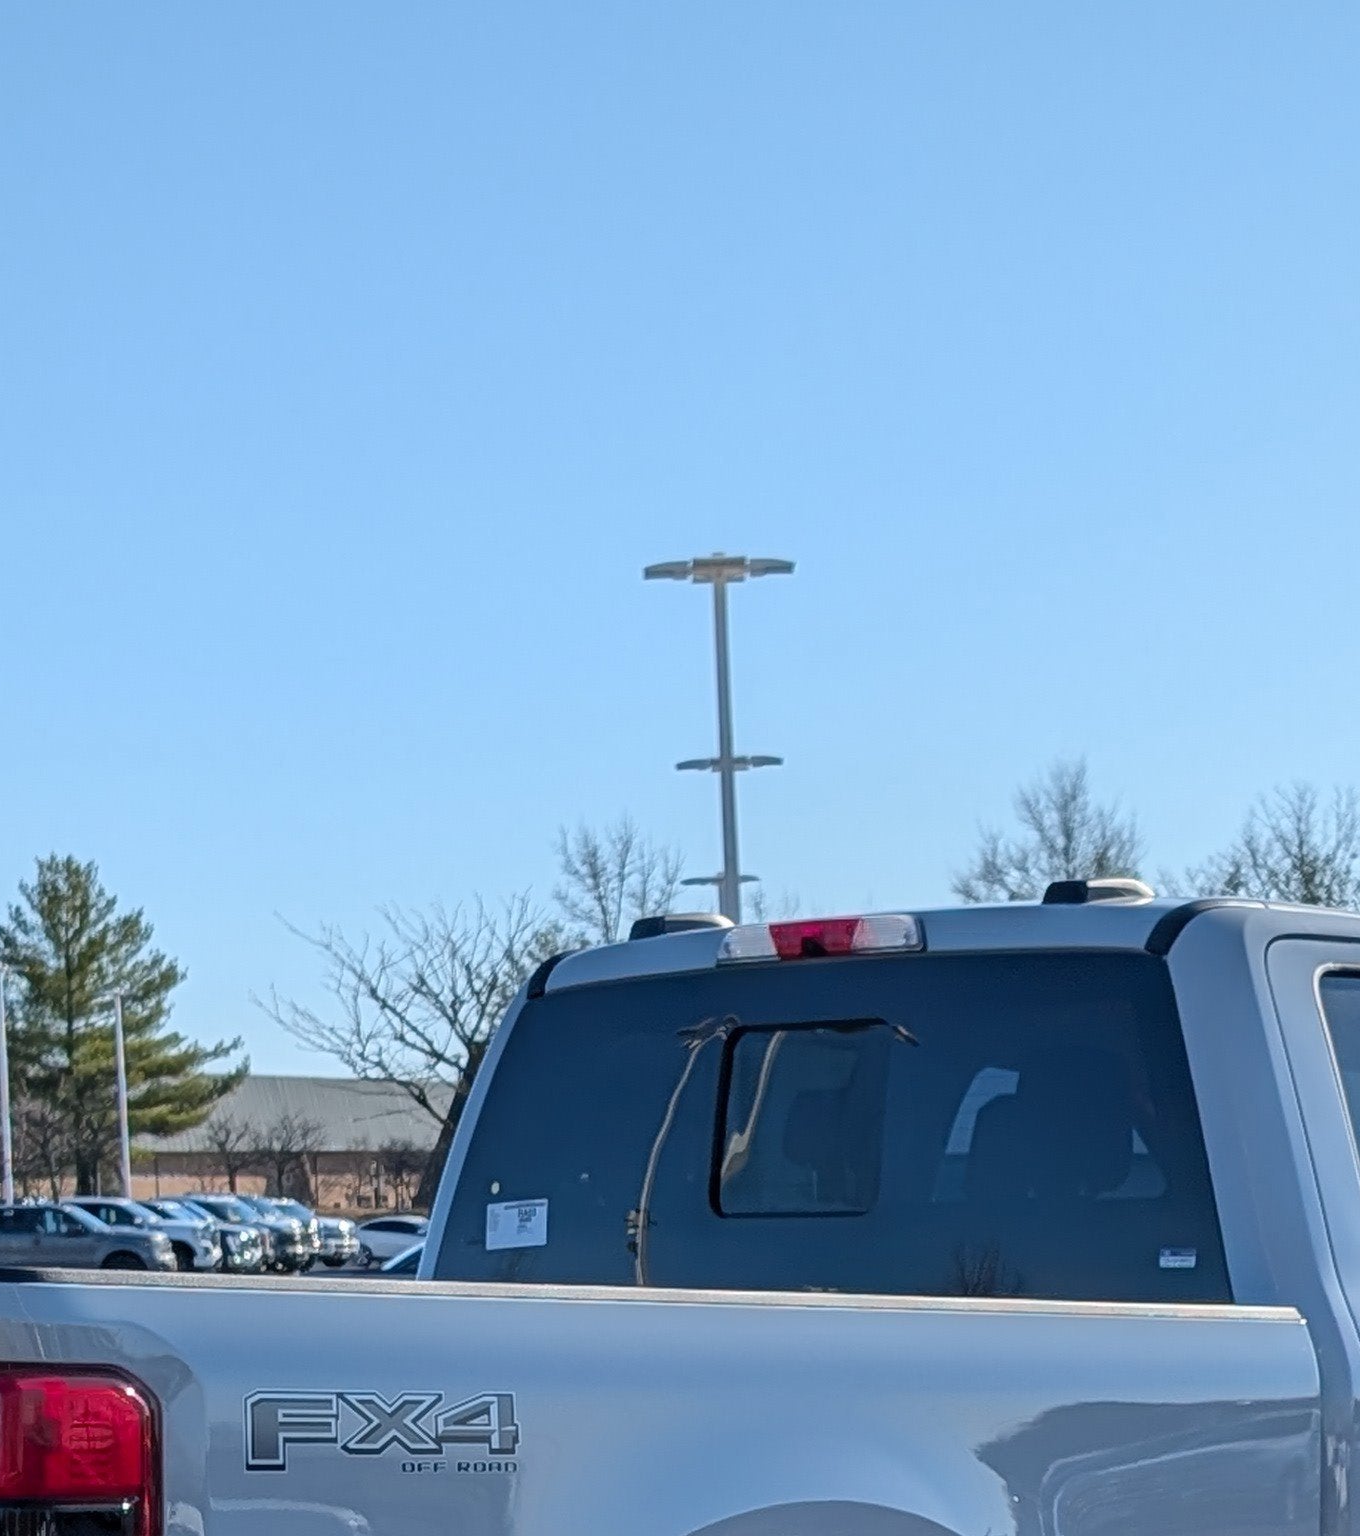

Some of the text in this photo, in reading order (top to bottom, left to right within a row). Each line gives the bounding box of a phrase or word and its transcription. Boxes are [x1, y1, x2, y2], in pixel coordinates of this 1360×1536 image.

[244, 1389, 520, 1473] FX4
[401, 1461, 518, 1474] OFF ROAD
